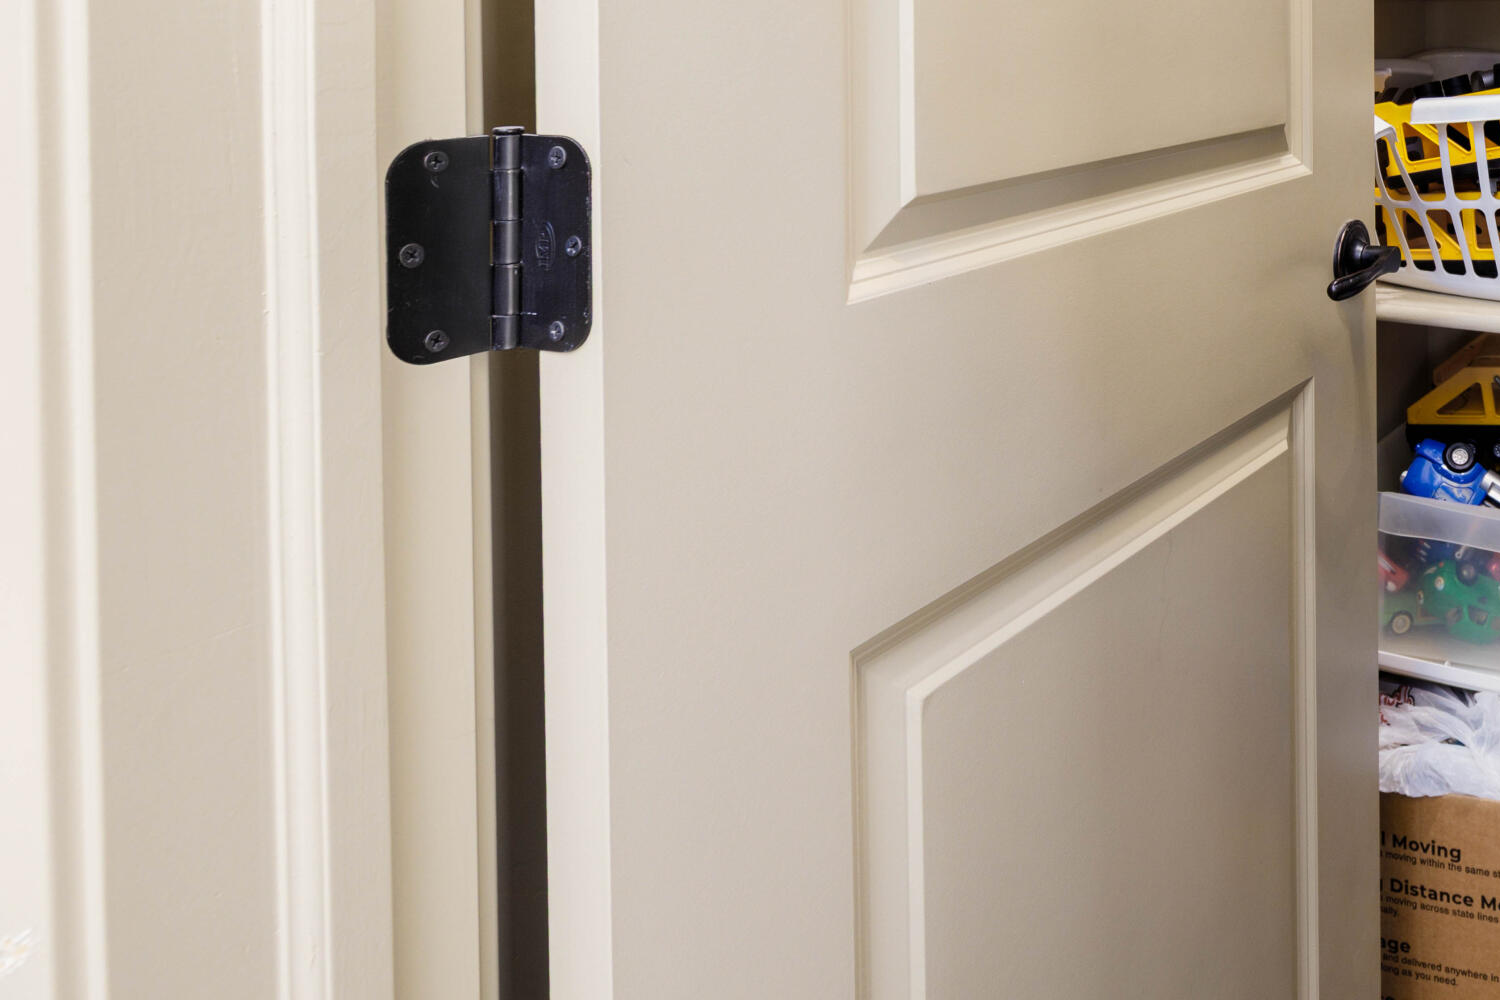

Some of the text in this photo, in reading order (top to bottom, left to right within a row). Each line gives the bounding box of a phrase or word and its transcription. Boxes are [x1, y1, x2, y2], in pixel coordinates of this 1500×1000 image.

[1392, 834, 1462, 863] Moving
[1385, 851, 1417, 866] moving
[1420, 857, 1445, 870] within
[1448, 863, 1462, 872] the
[1465, 867, 1490, 877] same
[1390, 878, 1474, 907] Distance
[1385, 896, 1417, 911] moving
[1420, 903, 1449, 916] across
[1452, 908, 1475, 920] state
[1477, 912, 1499, 924] lines
[1401, 957, 1442, 972] delivered
[1445, 967, 1488, 982] anywhere
[1491, 975, 1500, 983] in
[1402, 969, 1413, 977] as
[1415, 971, 1431, 982] you
